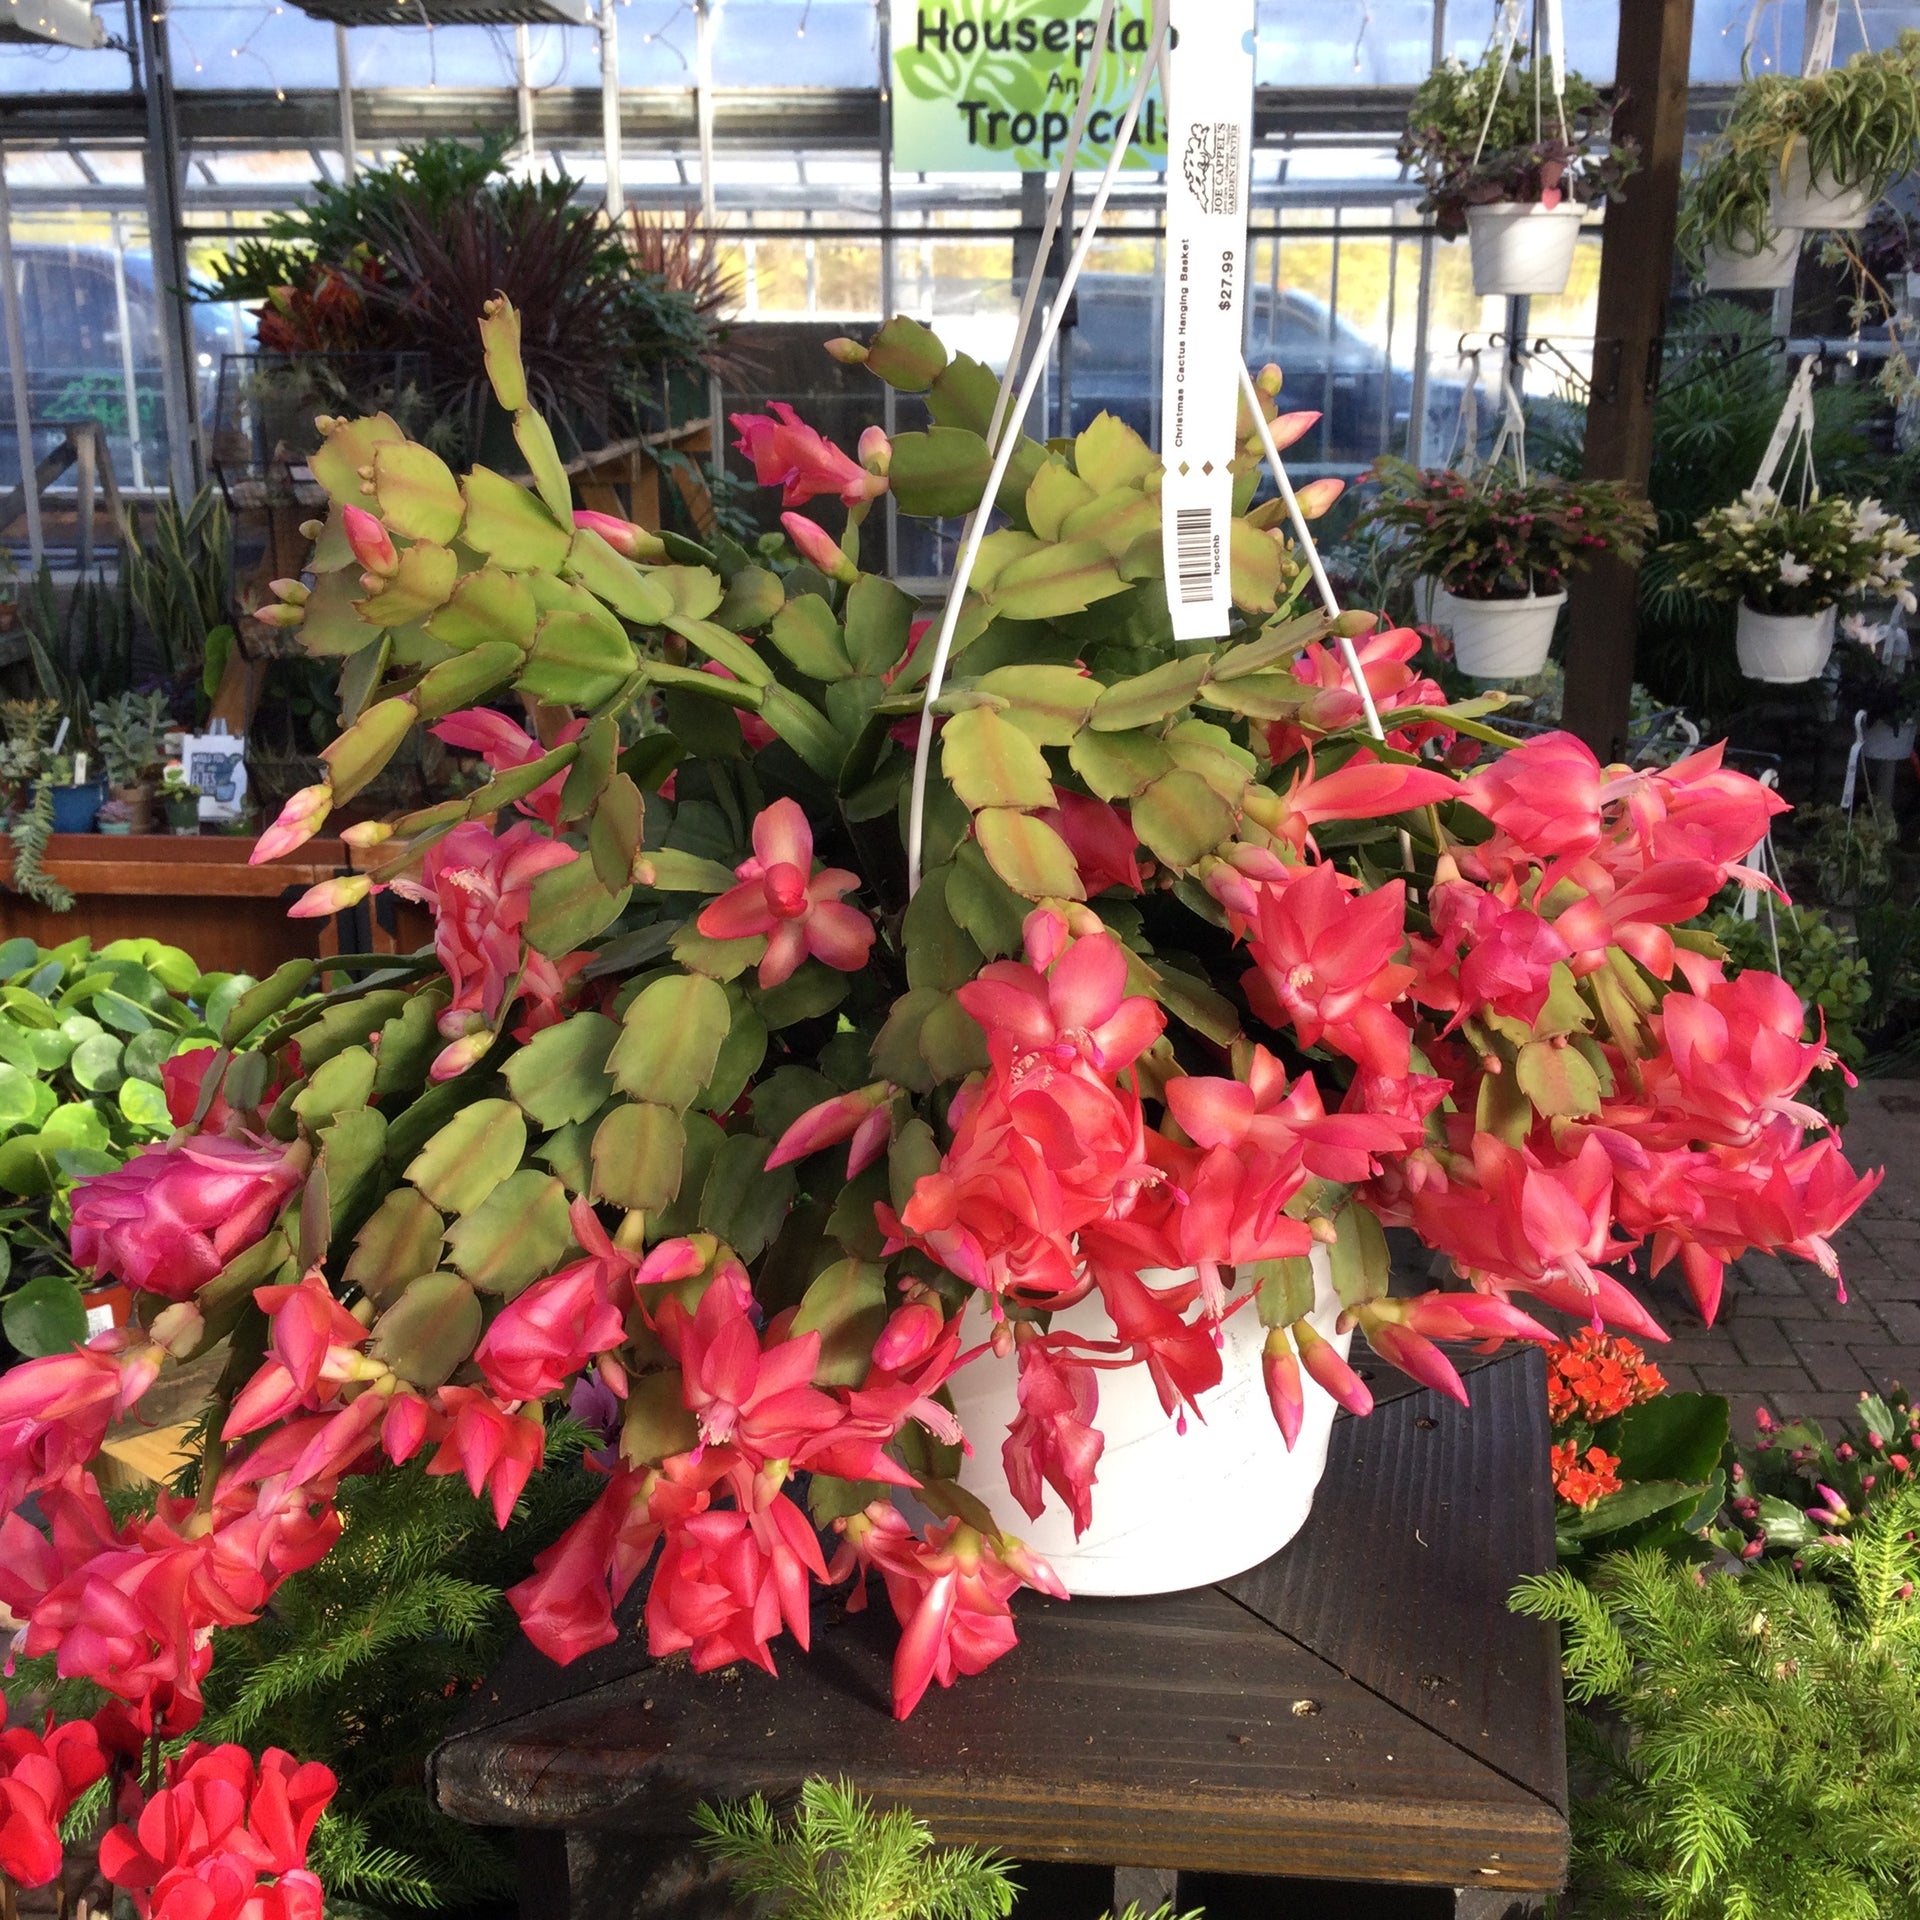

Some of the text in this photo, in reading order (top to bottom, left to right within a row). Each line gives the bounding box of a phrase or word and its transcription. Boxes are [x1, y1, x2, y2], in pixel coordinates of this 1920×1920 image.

[917, 8, 1179, 68] Housepla
[1046, 72, 1096, 95] An
[957, 98, 1168, 160] Tropcal
[1229, 124, 1238, 168] CENTER
[1214, 123, 1226, 214] JOE CAPPEL'S
[1227, 170, 1236, 215] GARDEN
[1218, 250, 1234, 311] $27.99
[1174, 238, 1190, 448] Christmas Cactus Hanging Basket
[1213, 534, 1221, 575] hpcchb
